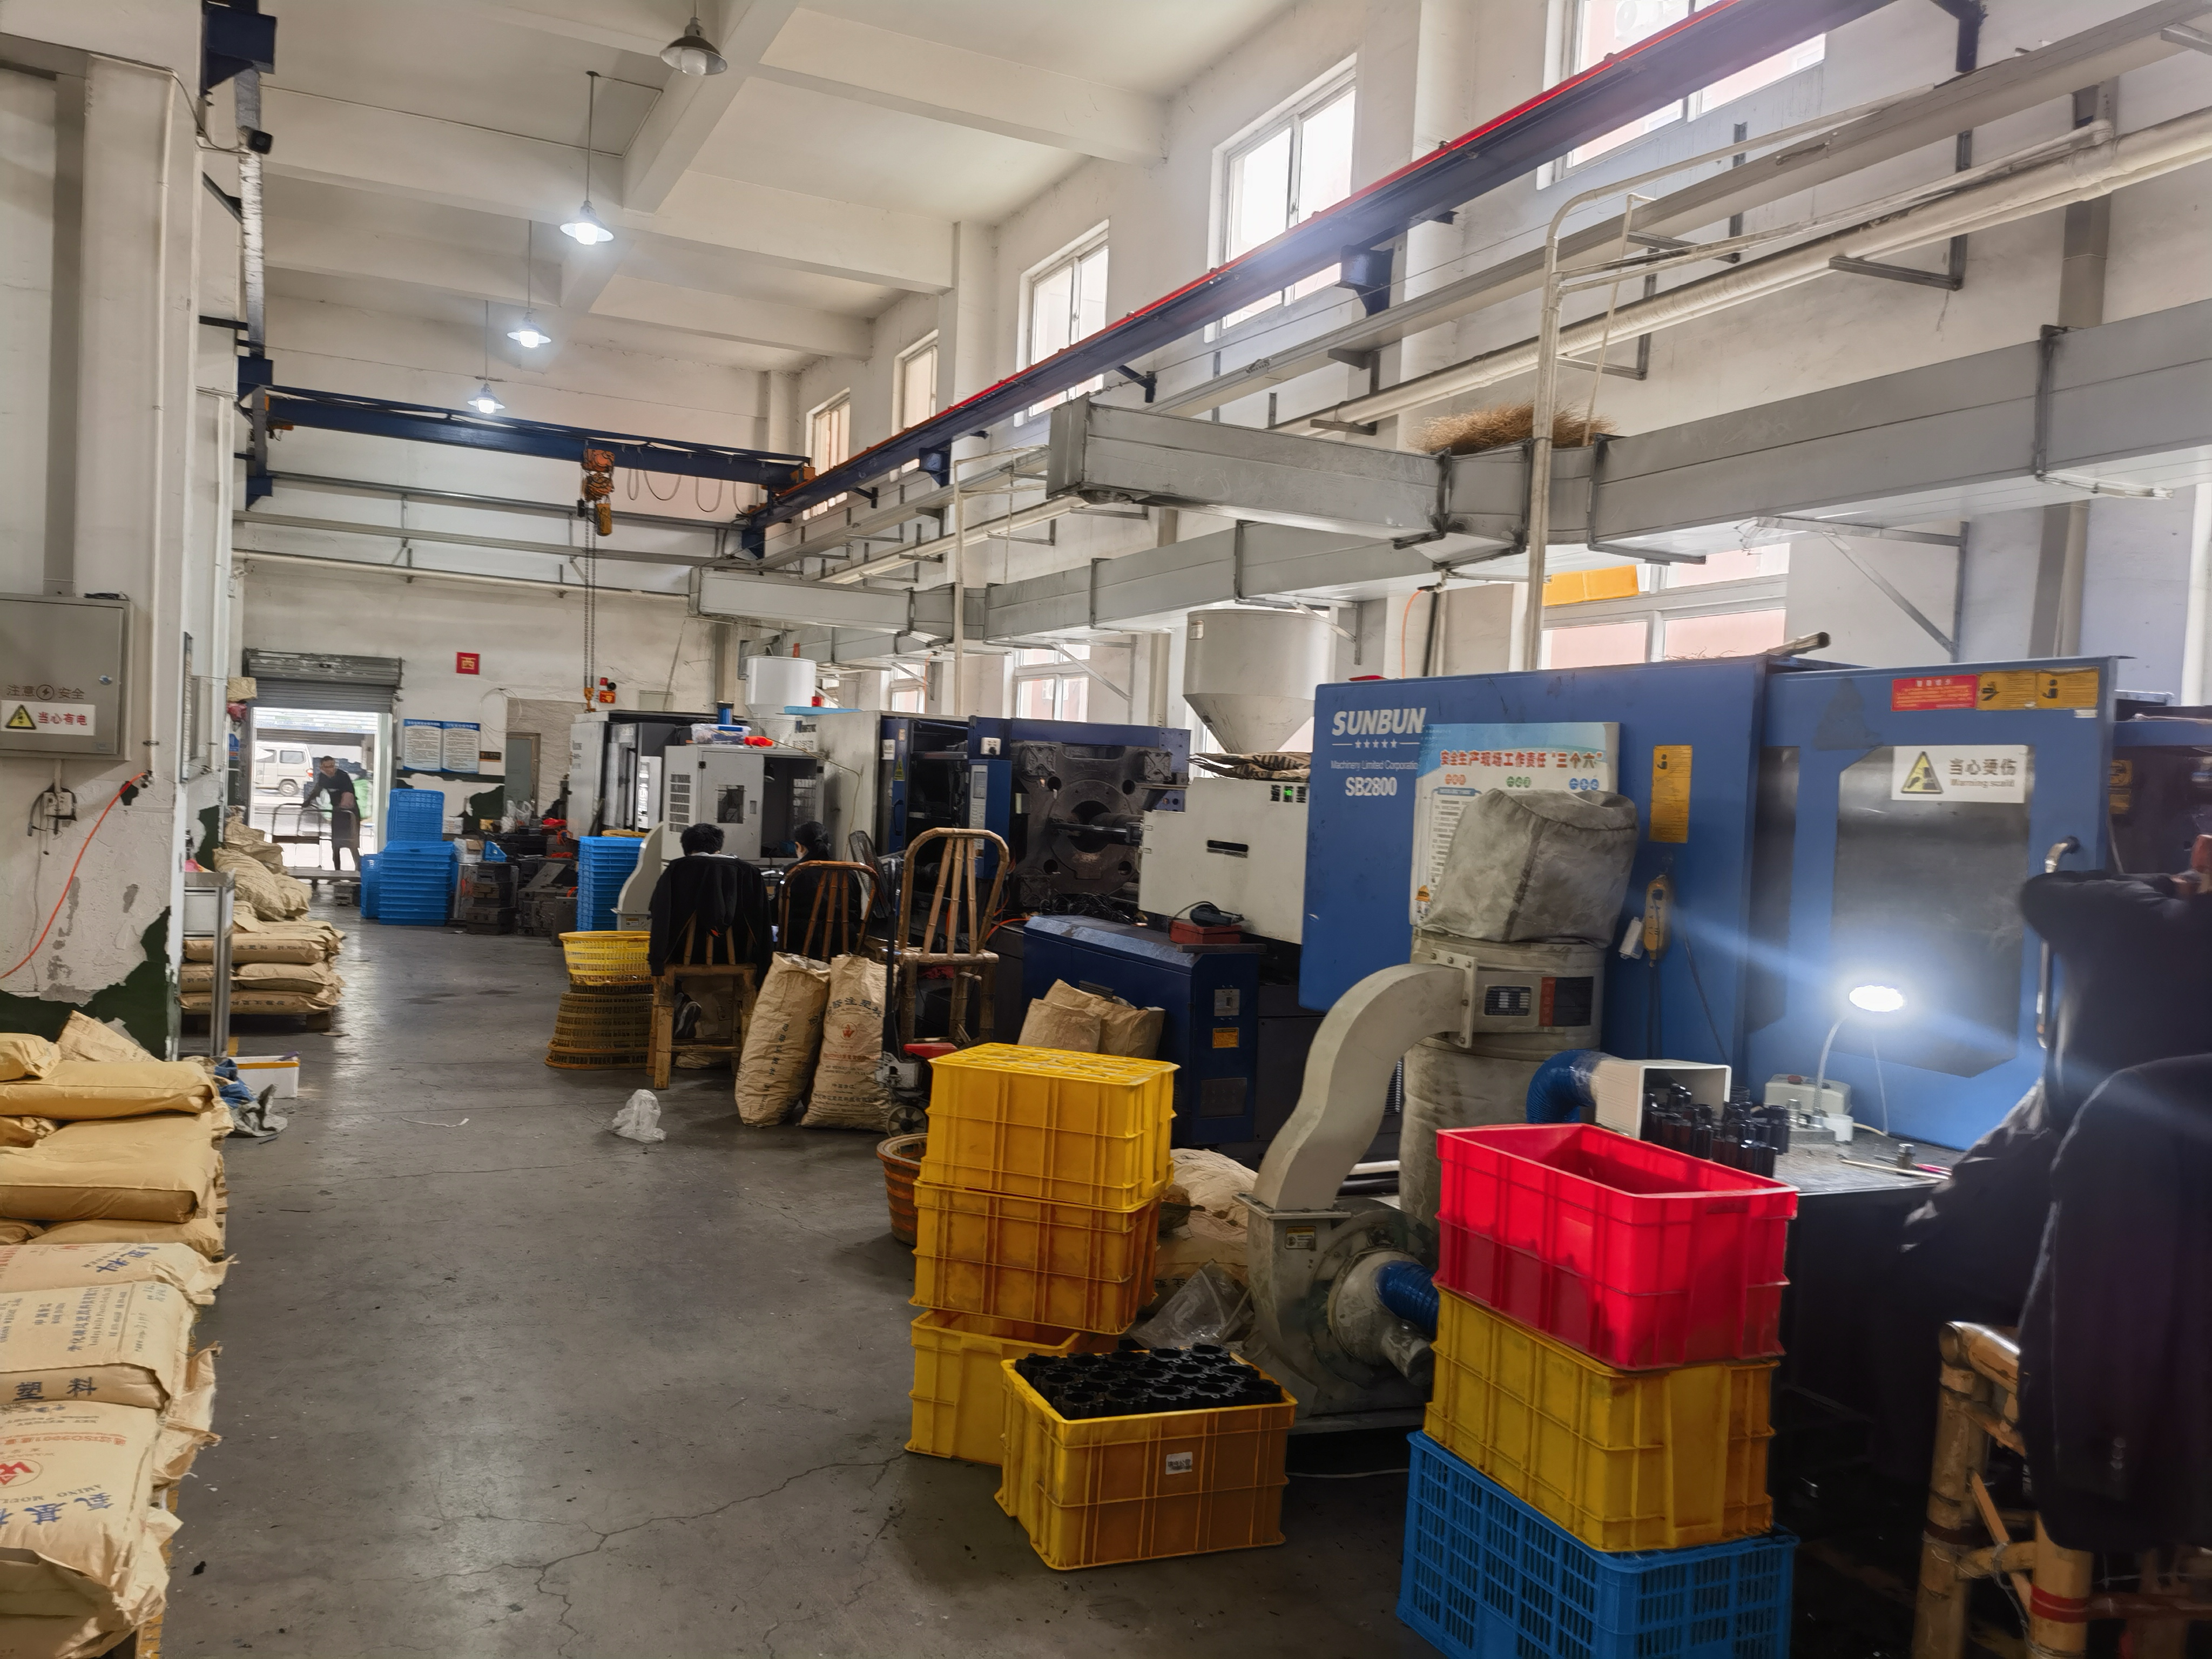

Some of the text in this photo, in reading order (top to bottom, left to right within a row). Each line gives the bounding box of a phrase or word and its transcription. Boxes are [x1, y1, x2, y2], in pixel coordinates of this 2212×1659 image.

[38, 712, 87, 726] 当心有电
[1332, 707, 1427, 736] SUNBUN
[1361, 760, 1384, 770] Limited
[1385, 760, 1419, 771] Corporatio
[1345, 777, 1398, 797] SB2800
[13, 1377, 98, 1401] 塑料
[57, 1484, 102, 1498] AMINO
